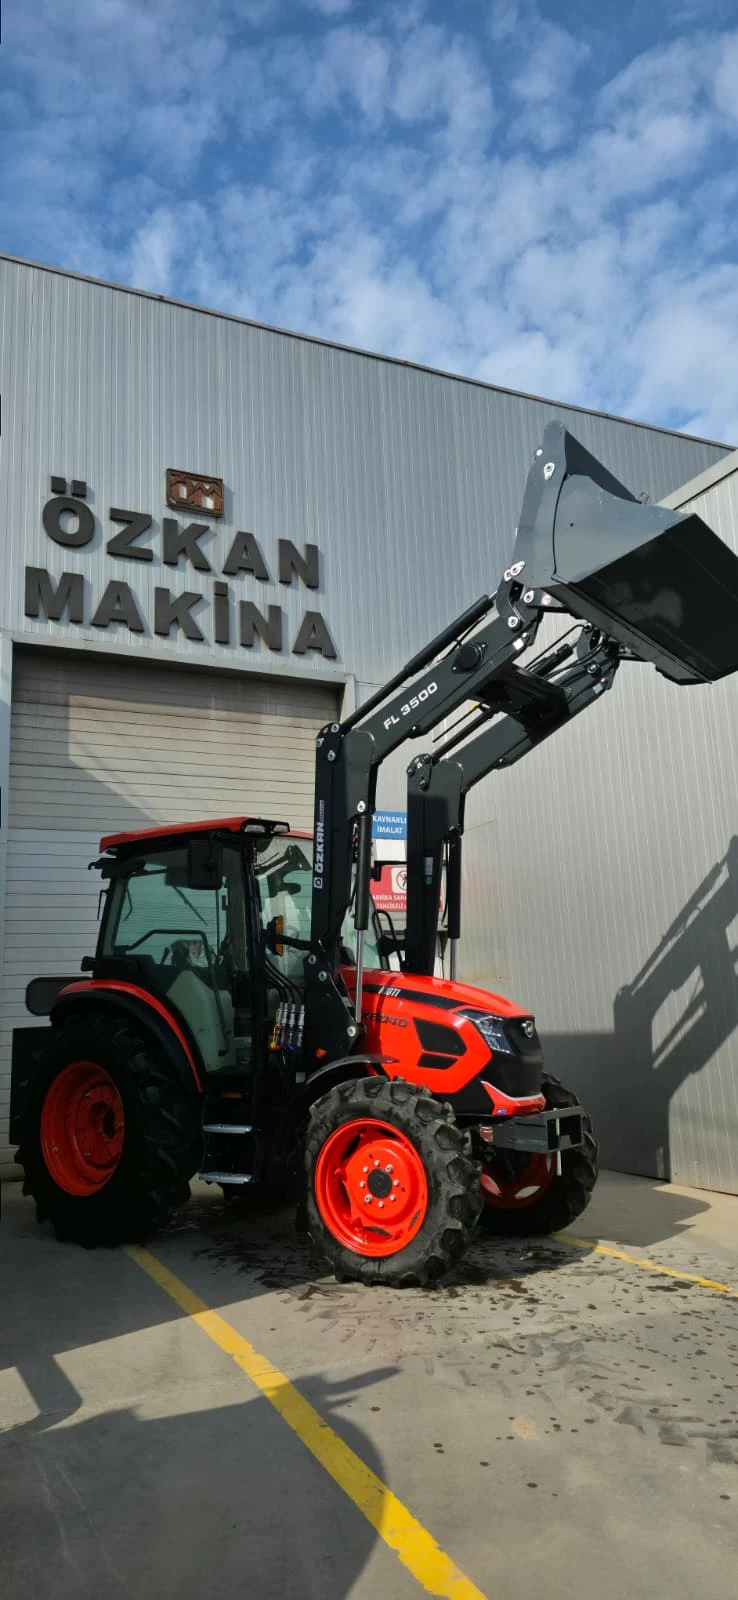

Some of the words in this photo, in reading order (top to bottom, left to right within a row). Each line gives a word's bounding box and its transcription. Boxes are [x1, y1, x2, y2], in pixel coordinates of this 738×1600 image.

[42, 475, 320, 590] ÖZKAN
[24, 565, 338, 659] MAKİNA
[383, 715, 400, 730] FL
[400, 681, 438, 716] 3500
[314, 822, 324, 874] ÖZKAN
